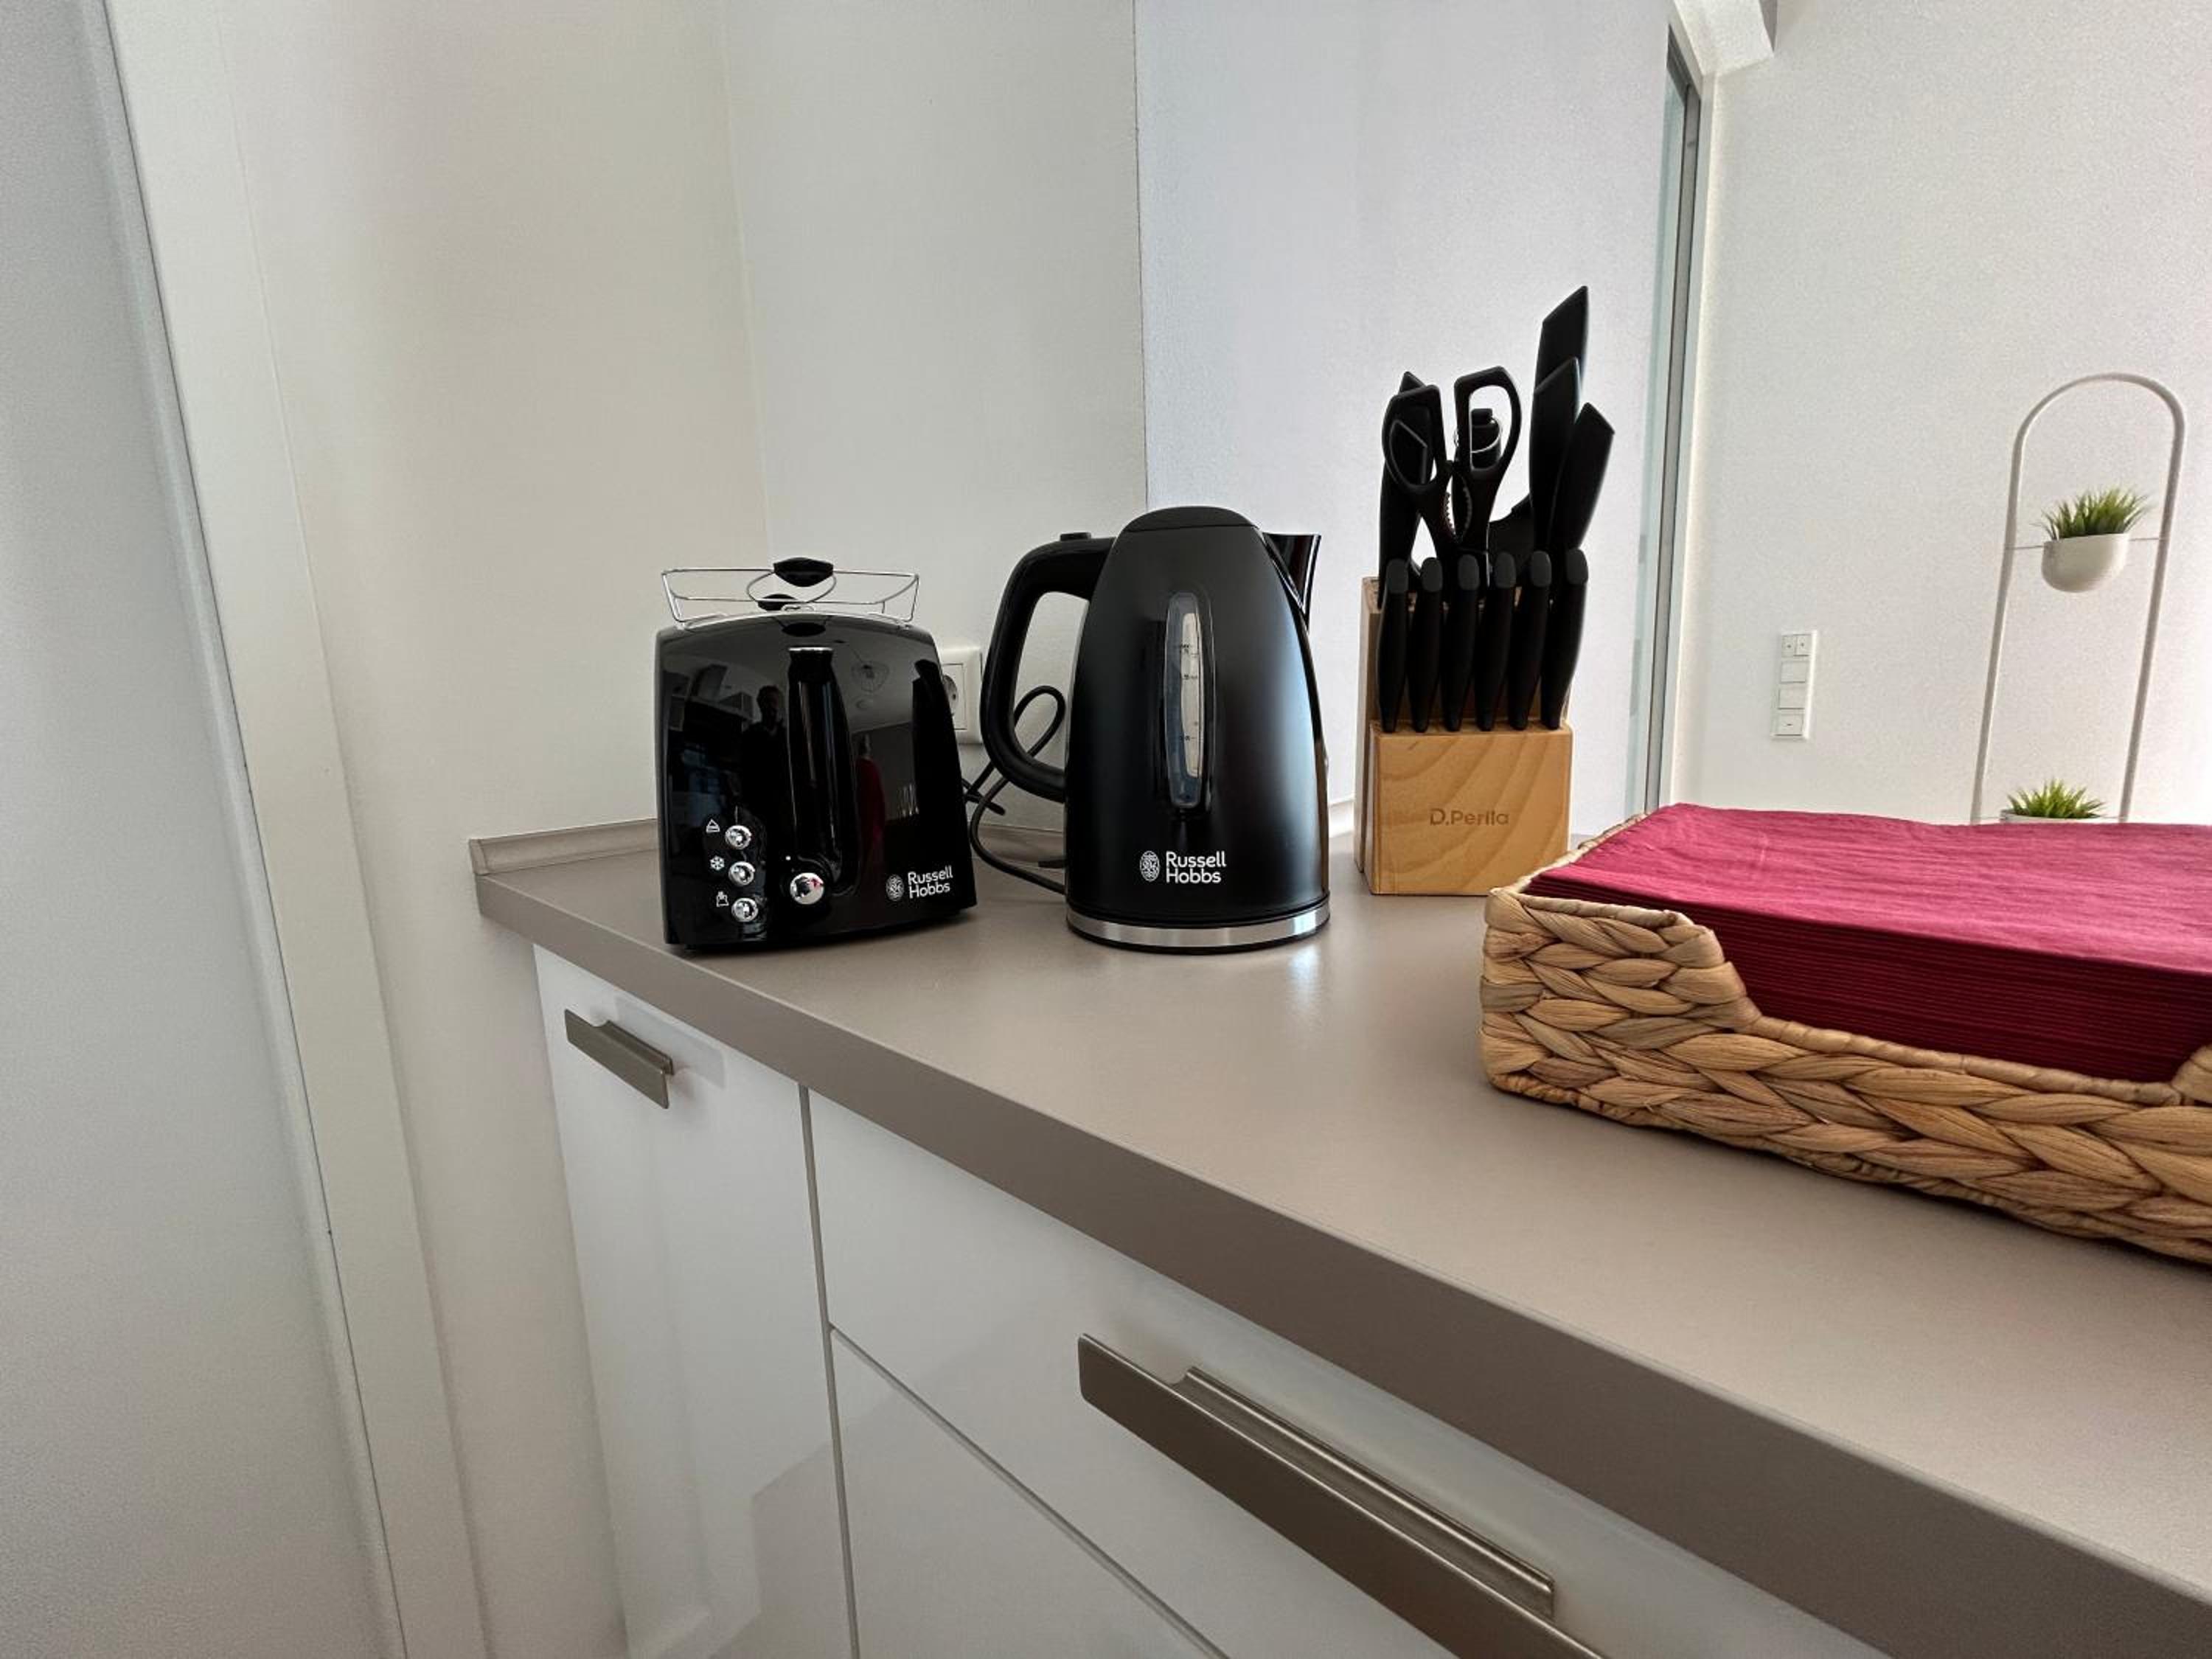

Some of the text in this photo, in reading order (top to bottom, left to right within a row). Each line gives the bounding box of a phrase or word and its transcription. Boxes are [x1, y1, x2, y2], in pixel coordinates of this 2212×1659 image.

[1166, 851, 1227, 868] Russell
[908, 865, 954, 886] Russell
[1166, 867, 1222, 883] Hobbs
[908, 881, 950, 899] Hobbs
